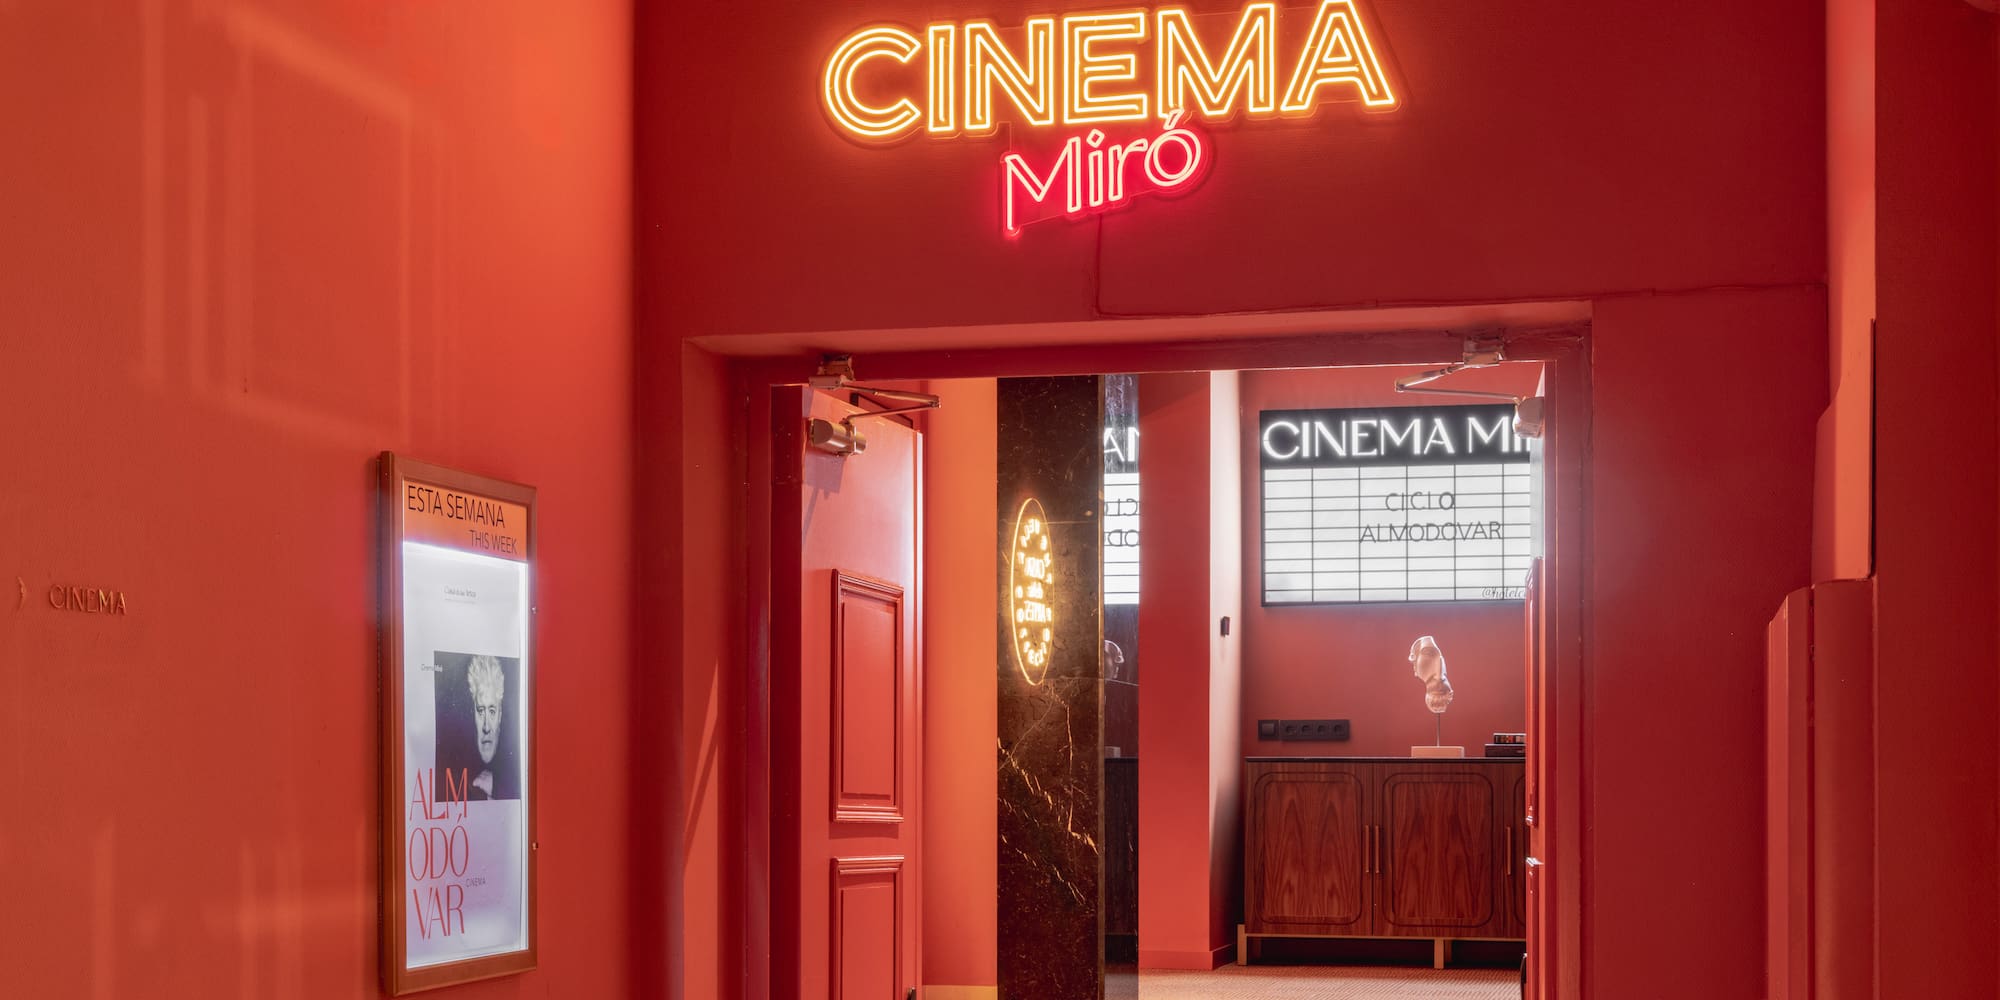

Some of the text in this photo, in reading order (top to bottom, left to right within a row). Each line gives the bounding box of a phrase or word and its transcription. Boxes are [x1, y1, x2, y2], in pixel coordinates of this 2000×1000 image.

[824, 0, 1396, 137] CINEMA
[1003, 109, 1203, 233] Miró
[1263, 415, 1530, 459] CINEMA MI
[407, 485, 505, 528] ESTA SEMANA
[1385, 491, 1455, 511] CICLO
[469, 529, 518, 555] THIS WEEK
[1360, 521, 1502, 543] ALMODOVAR
[48, 583, 127, 616] CINEMA
[1481, 585, 1527, 600] @hotelc
[409, 767, 468, 821] ALM
[412, 884, 465, 941] VAR
